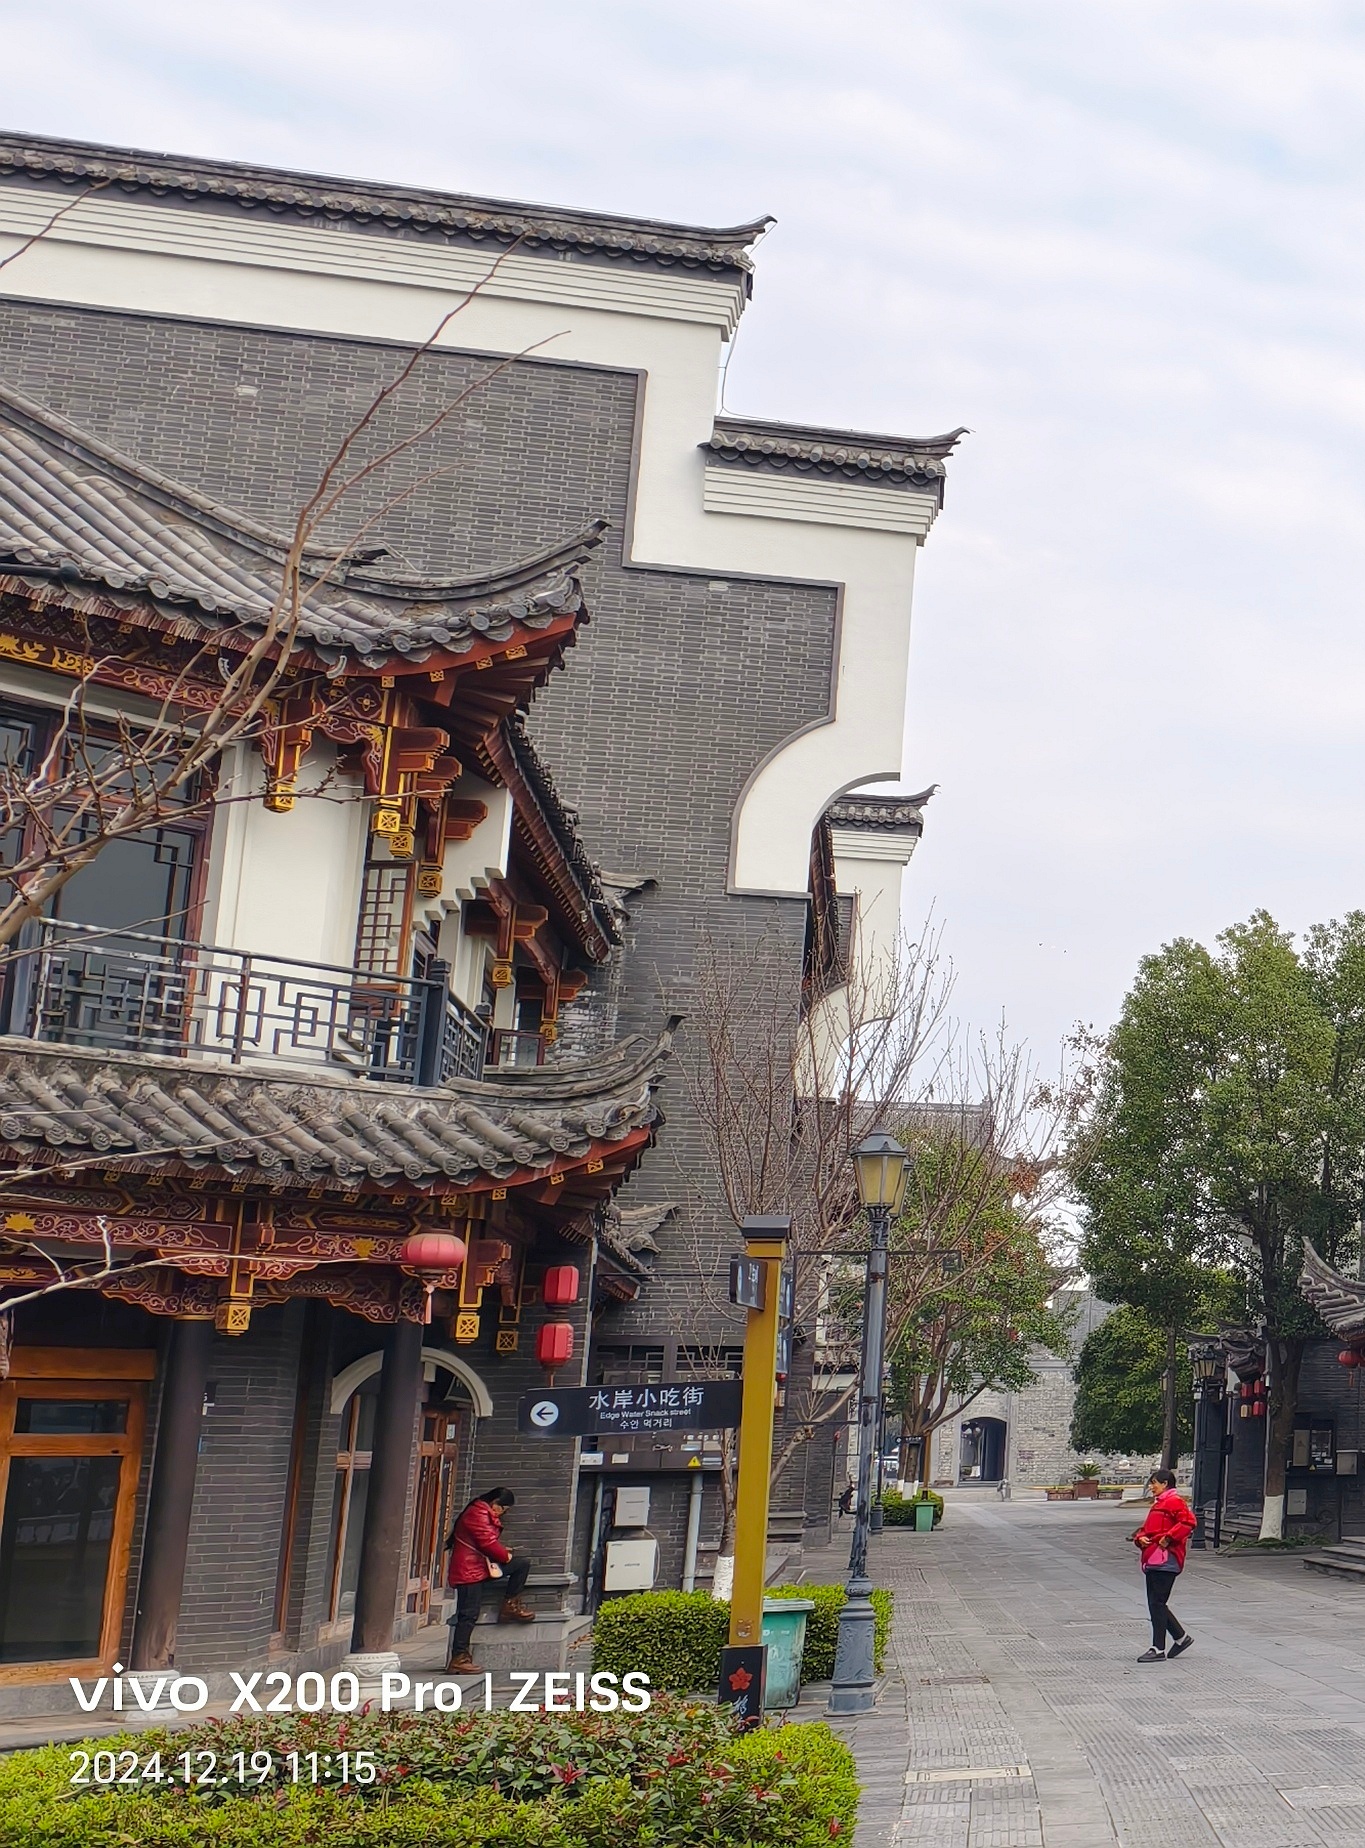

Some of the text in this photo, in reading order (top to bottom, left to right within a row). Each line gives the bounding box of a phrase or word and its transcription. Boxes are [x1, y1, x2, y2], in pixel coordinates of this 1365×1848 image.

[589, 1387, 704, 1410] 水岸小吃街
[600, 1408, 692, 1420] Edge Water Snack street
